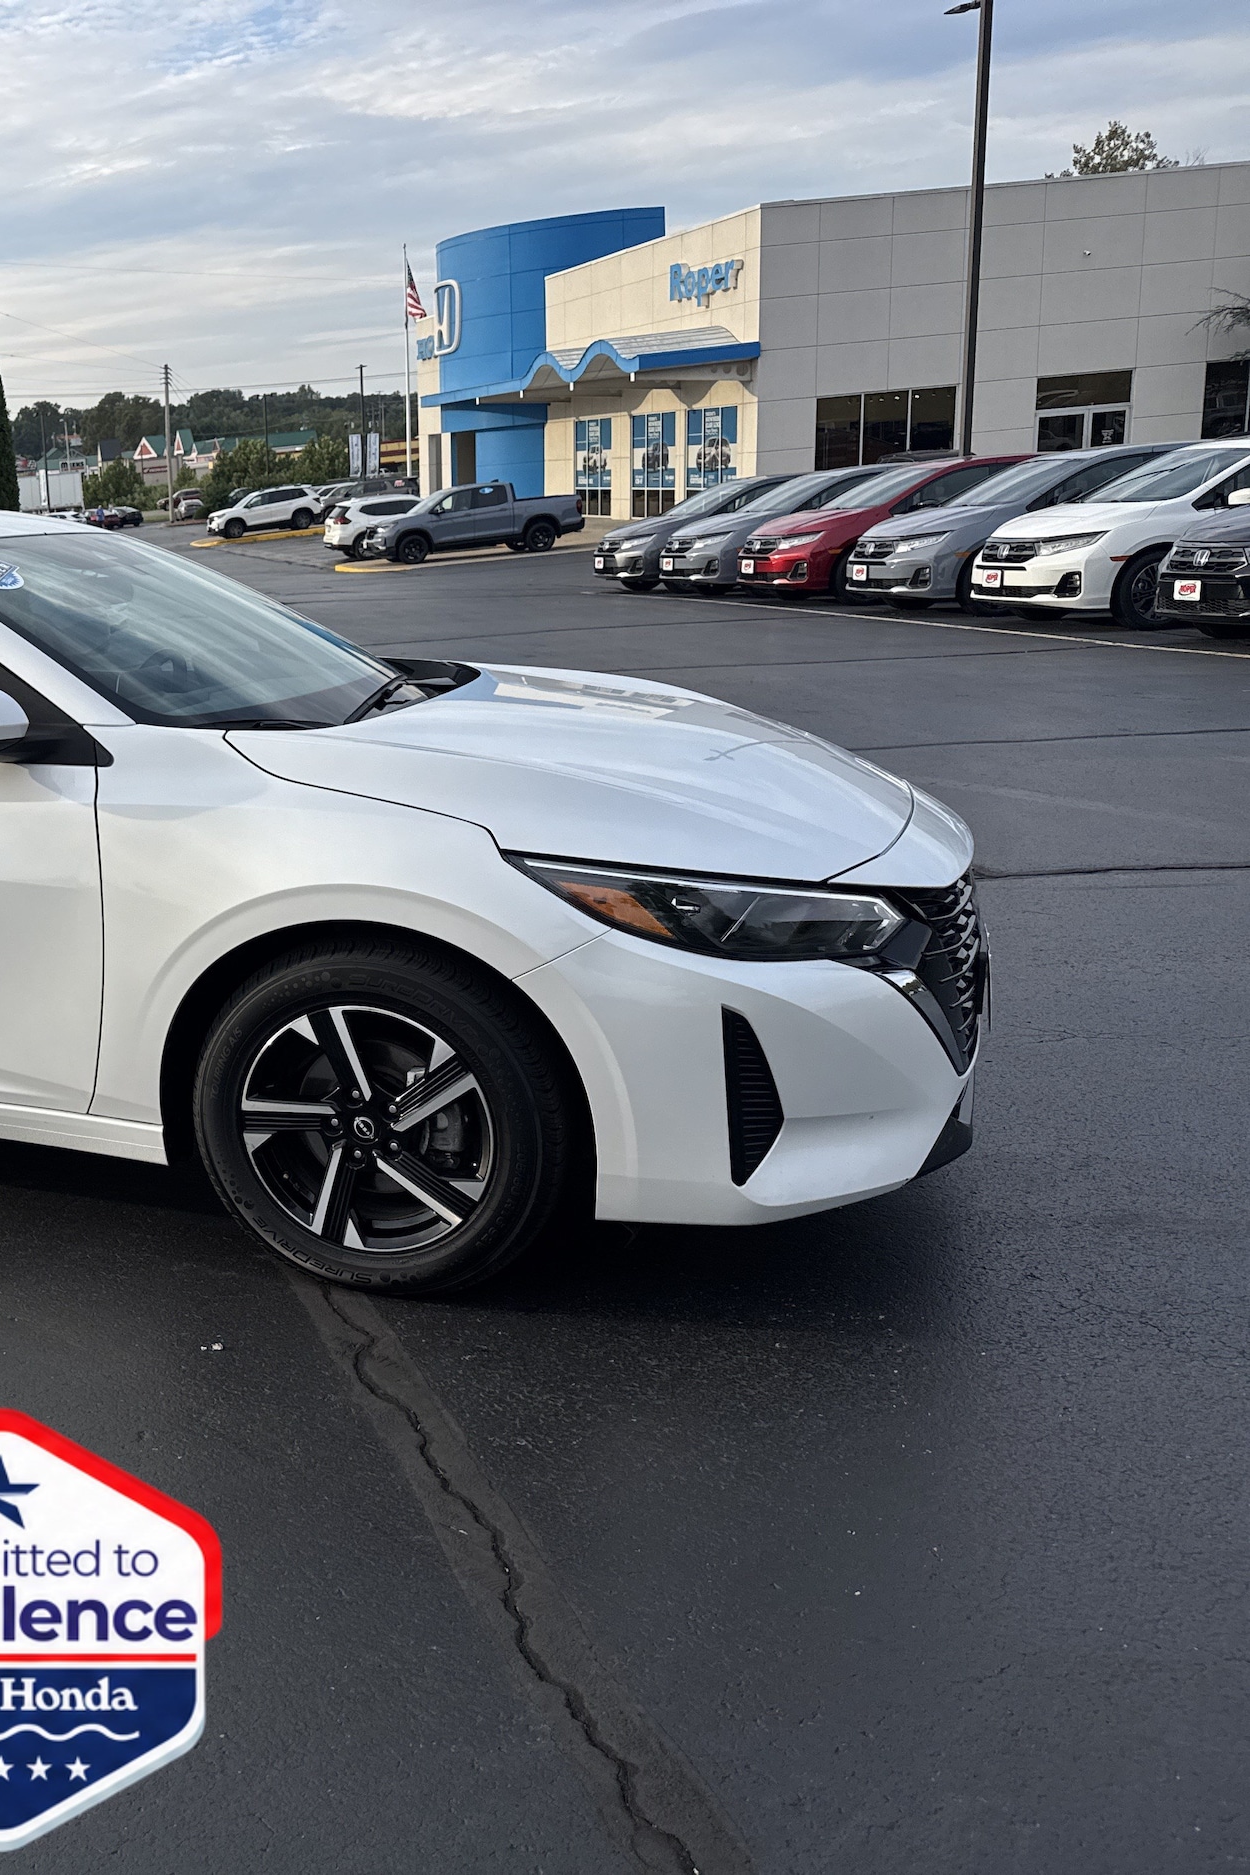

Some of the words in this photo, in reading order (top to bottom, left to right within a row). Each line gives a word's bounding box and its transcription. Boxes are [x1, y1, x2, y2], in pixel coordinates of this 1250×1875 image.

[670, 259, 740, 308] Roper
[210, 1045, 231, 1099] TOURING
[252, 1215, 373, 1284] SUREDRIVE
